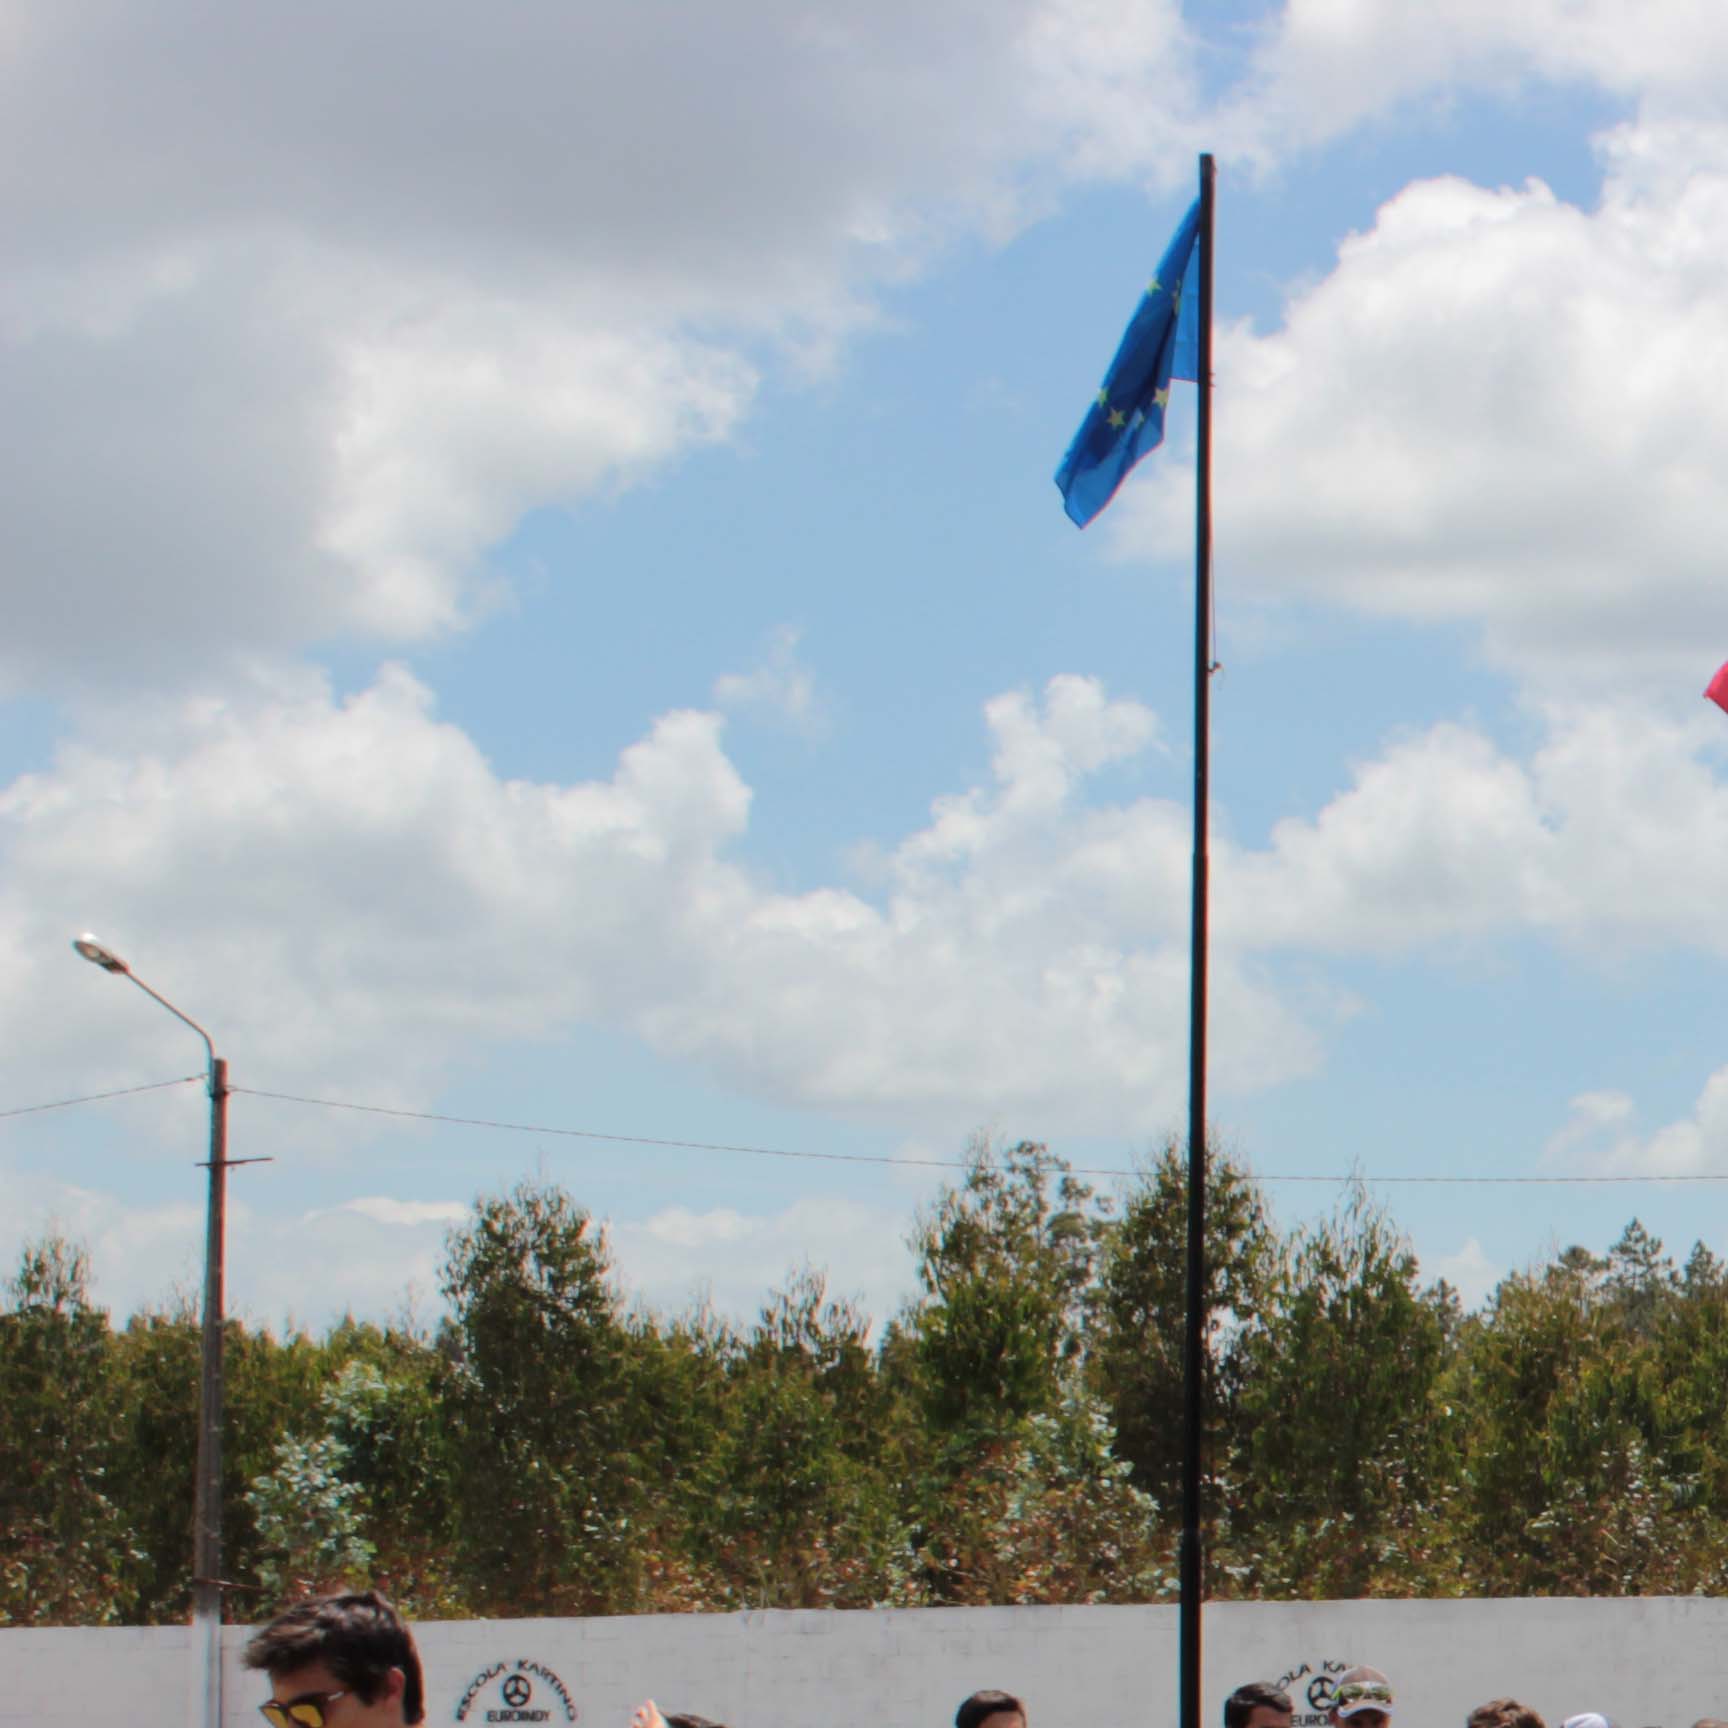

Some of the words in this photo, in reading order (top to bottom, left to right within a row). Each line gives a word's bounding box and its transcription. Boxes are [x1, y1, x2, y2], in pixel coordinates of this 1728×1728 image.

[457, 1662, 508, 1721] ESCOLA
[517, 1659, 578, 1722] KARTING
[487, 1709, 551, 1722] EUROINDY
[1292, 1713, 1331, 1728] EURO
